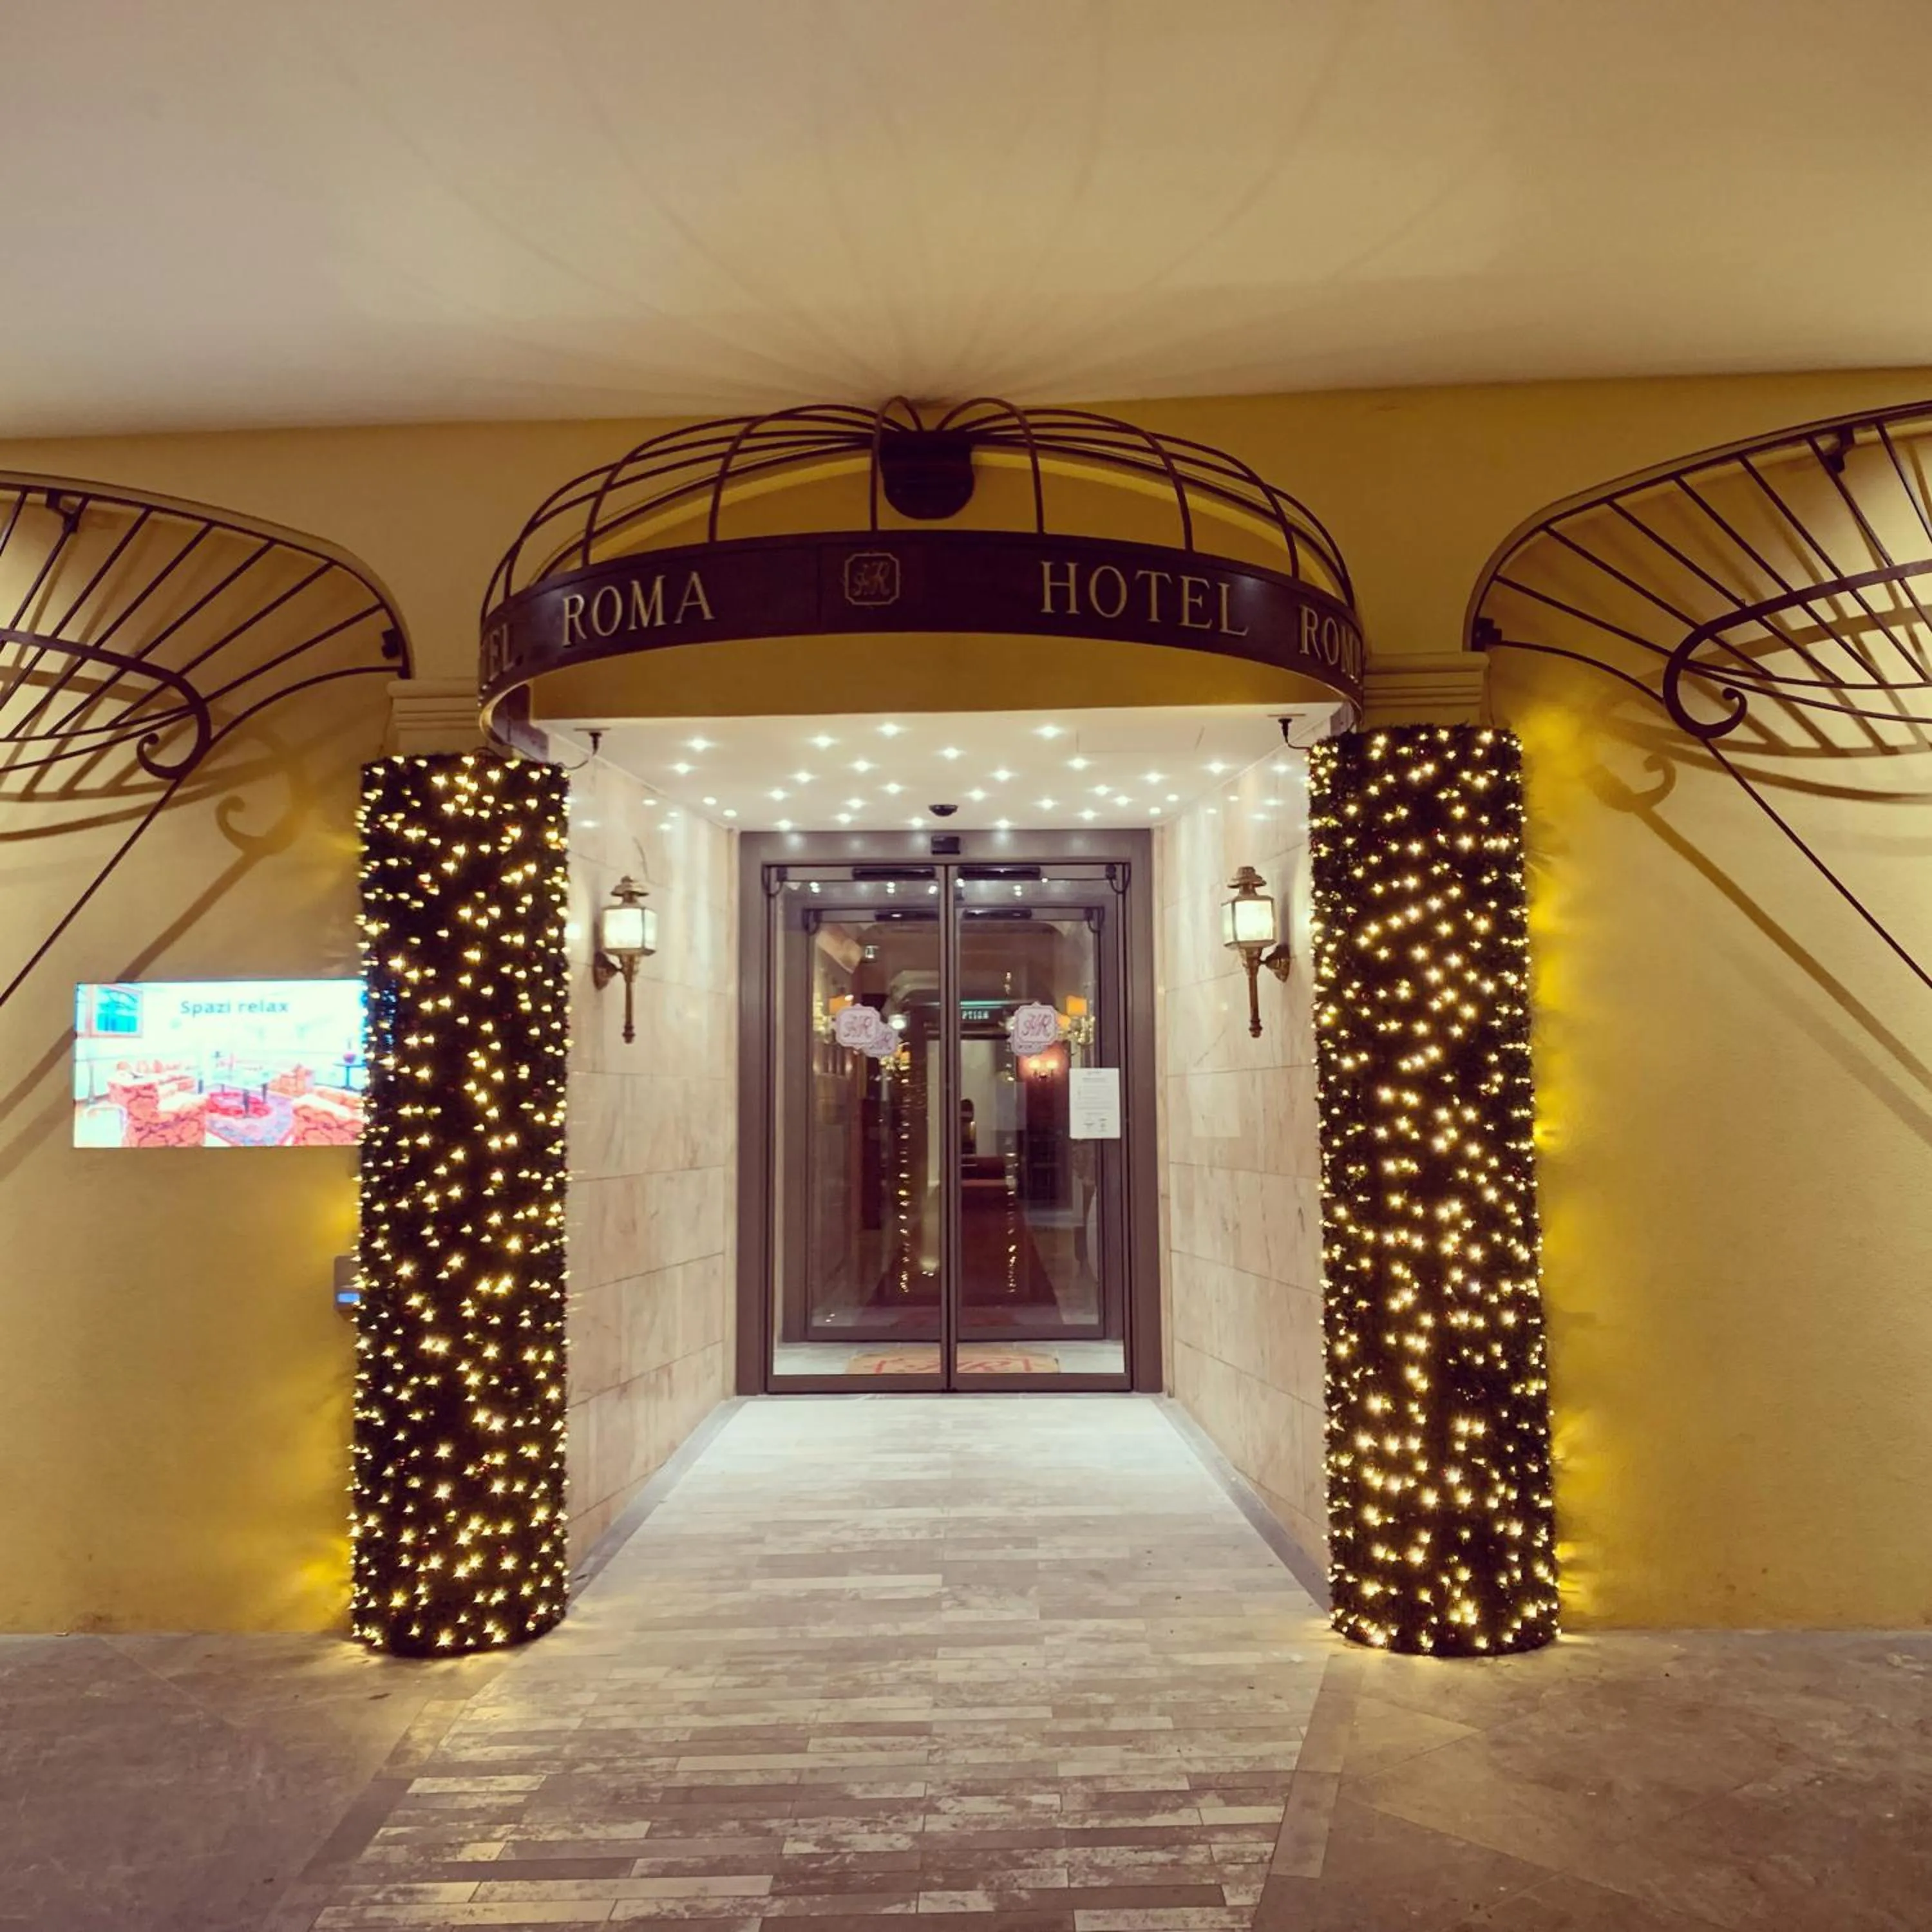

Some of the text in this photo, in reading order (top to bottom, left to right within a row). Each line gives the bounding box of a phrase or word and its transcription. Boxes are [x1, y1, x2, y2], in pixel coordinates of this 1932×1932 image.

[562, 571, 715, 648] ROMA
[1039, 560, 1361, 683] HOTEL ROM
[180, 999, 289, 1018] Spazi relax
